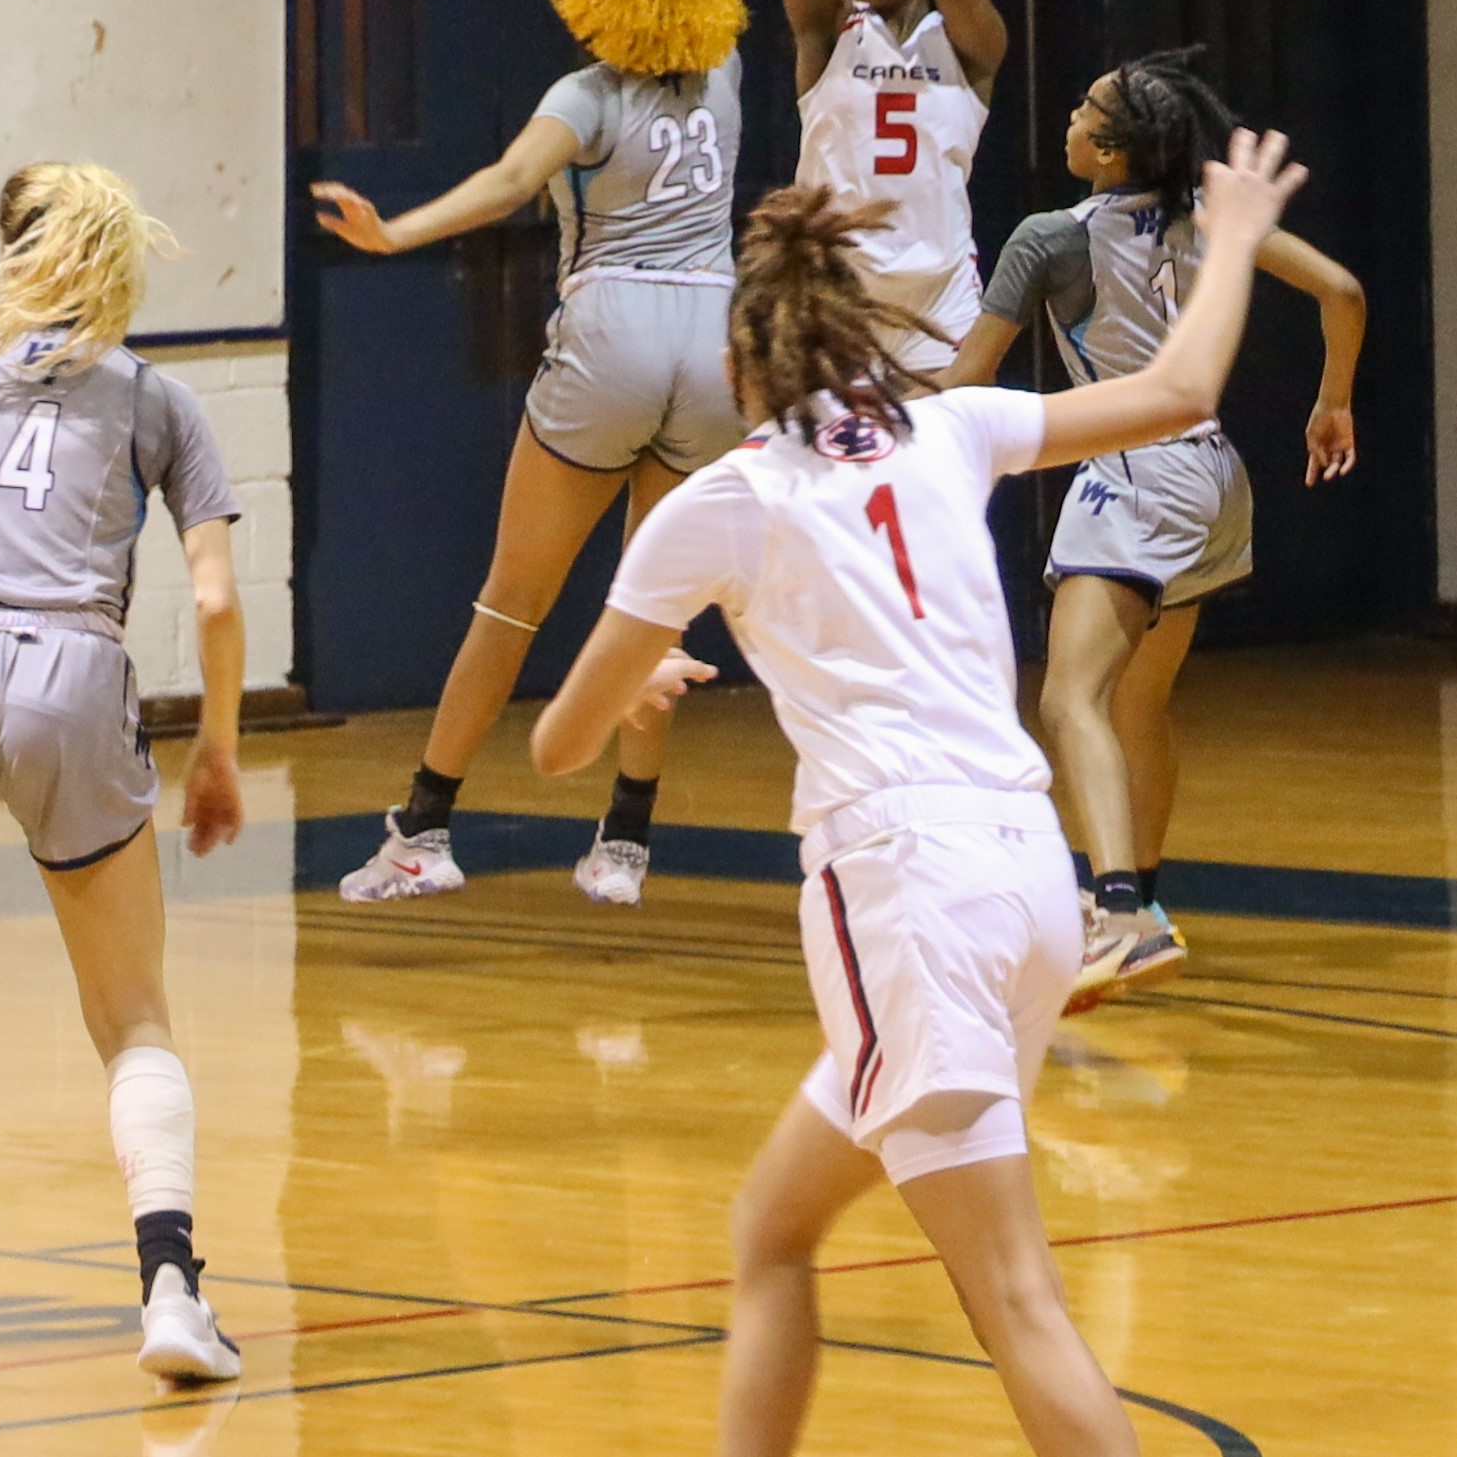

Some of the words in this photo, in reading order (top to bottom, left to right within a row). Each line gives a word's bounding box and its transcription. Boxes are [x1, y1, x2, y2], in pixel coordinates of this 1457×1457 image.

[852, 64, 941, 82] CANES
[645, 106, 724, 205] 23
[873, 92, 918, 176] 5
[864, 482, 926, 620] 1
